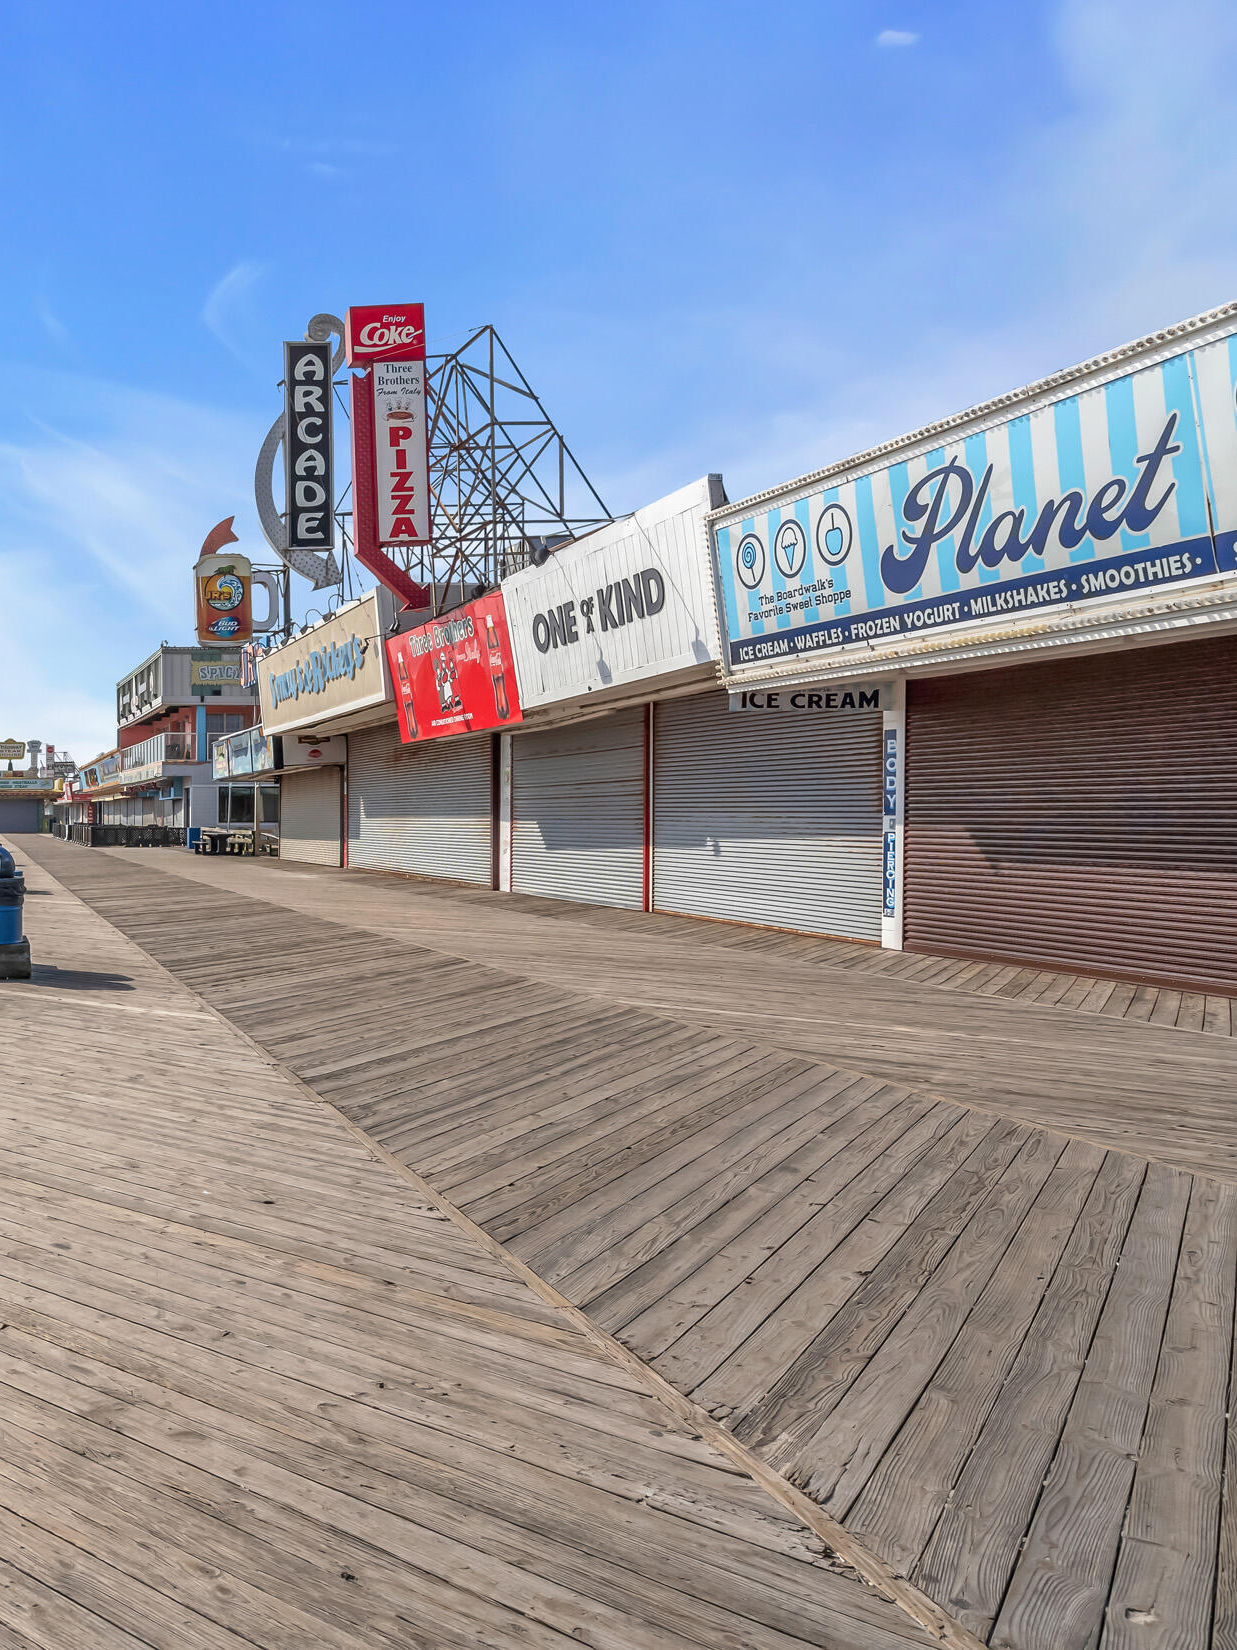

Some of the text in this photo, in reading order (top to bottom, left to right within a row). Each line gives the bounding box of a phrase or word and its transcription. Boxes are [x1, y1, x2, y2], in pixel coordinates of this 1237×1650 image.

[360, 322, 415, 345] Coke
[382, 315, 406, 323] Enjoy
[377, 375, 420, 386] Brothers
[384, 364, 413, 373] Three
[376, 387, 422, 396] From Italy
[294, 353, 326, 540] ARCADE
[389, 426, 418, 538] PIZZA
[881, 412, 1180, 593] Planet
[739, 552, 1192, 661] ICE CREAM WAFFLES FROZEN YOGURT MILKSHAKES SMOOTHIES
[748, 589, 851, 622] Favorite Sweet Shoppe
[758, 578, 834, 606] The Boardwalk's
[533, 568, 665, 654] ONE OF A KIND
[408, 616, 474, 657] Three Brothers
[741, 689, 879, 709] ICE CREAM
[885, 739, 897, 809] BODY
[885, 833, 896, 908] PIERCING
